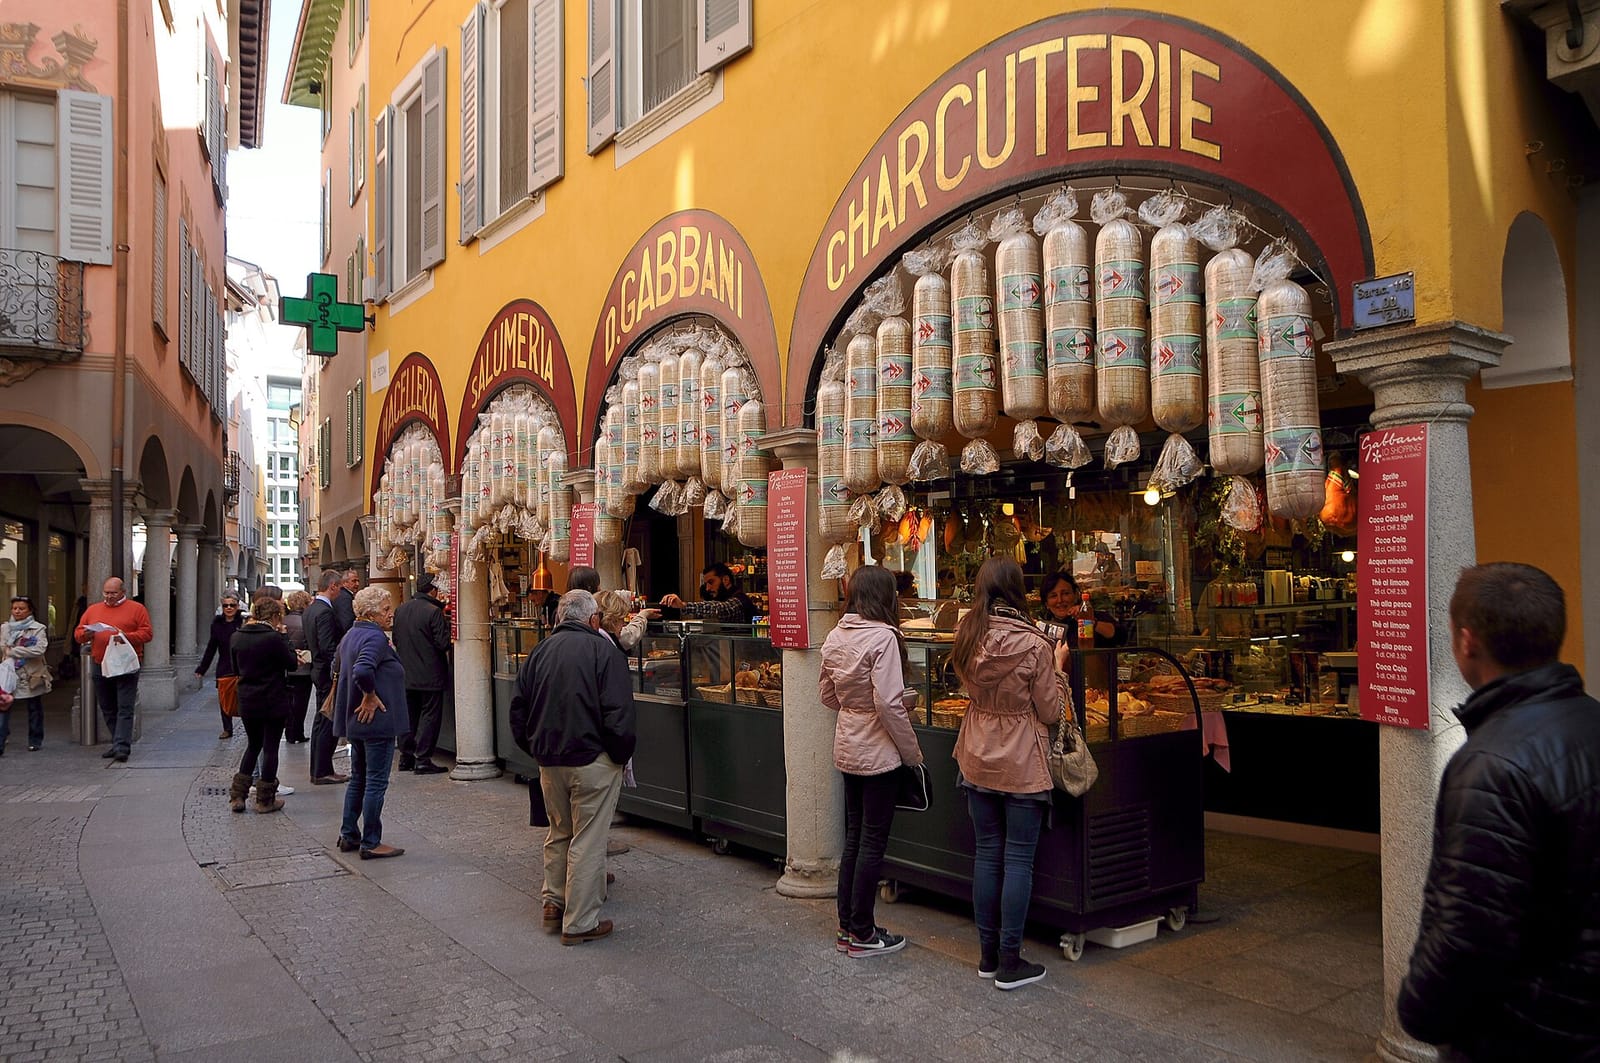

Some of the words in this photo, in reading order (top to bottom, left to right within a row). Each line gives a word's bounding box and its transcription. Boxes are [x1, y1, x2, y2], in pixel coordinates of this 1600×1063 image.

[826, 34, 1221, 291] CHARCUTERIE
[471, 313, 554, 409] SALUMERIA
[382, 365, 439, 451] MACELLERIA
[1361, 431, 1424, 462] Gabbani
[1382, 473, 1399, 482] Sprite
[1382, 494, 1398, 502] Fanta
[1385, 515, 1400, 523] Cola
[1400, 514, 1414, 524] light
[1392, 536, 1406, 544] Cola
[1368, 558, 1387, 566] Acqua
[1388, 557, 1414, 565] minerale
[1390, 622, 1410, 630] limone
[1394, 644, 1412, 652] pesca
[1376, 662, 1391, 671] Coca
[1392, 664, 1407, 672] Cola
[1370, 683, 1388, 692] Acqua
[1388, 686, 1416, 696] minerale
